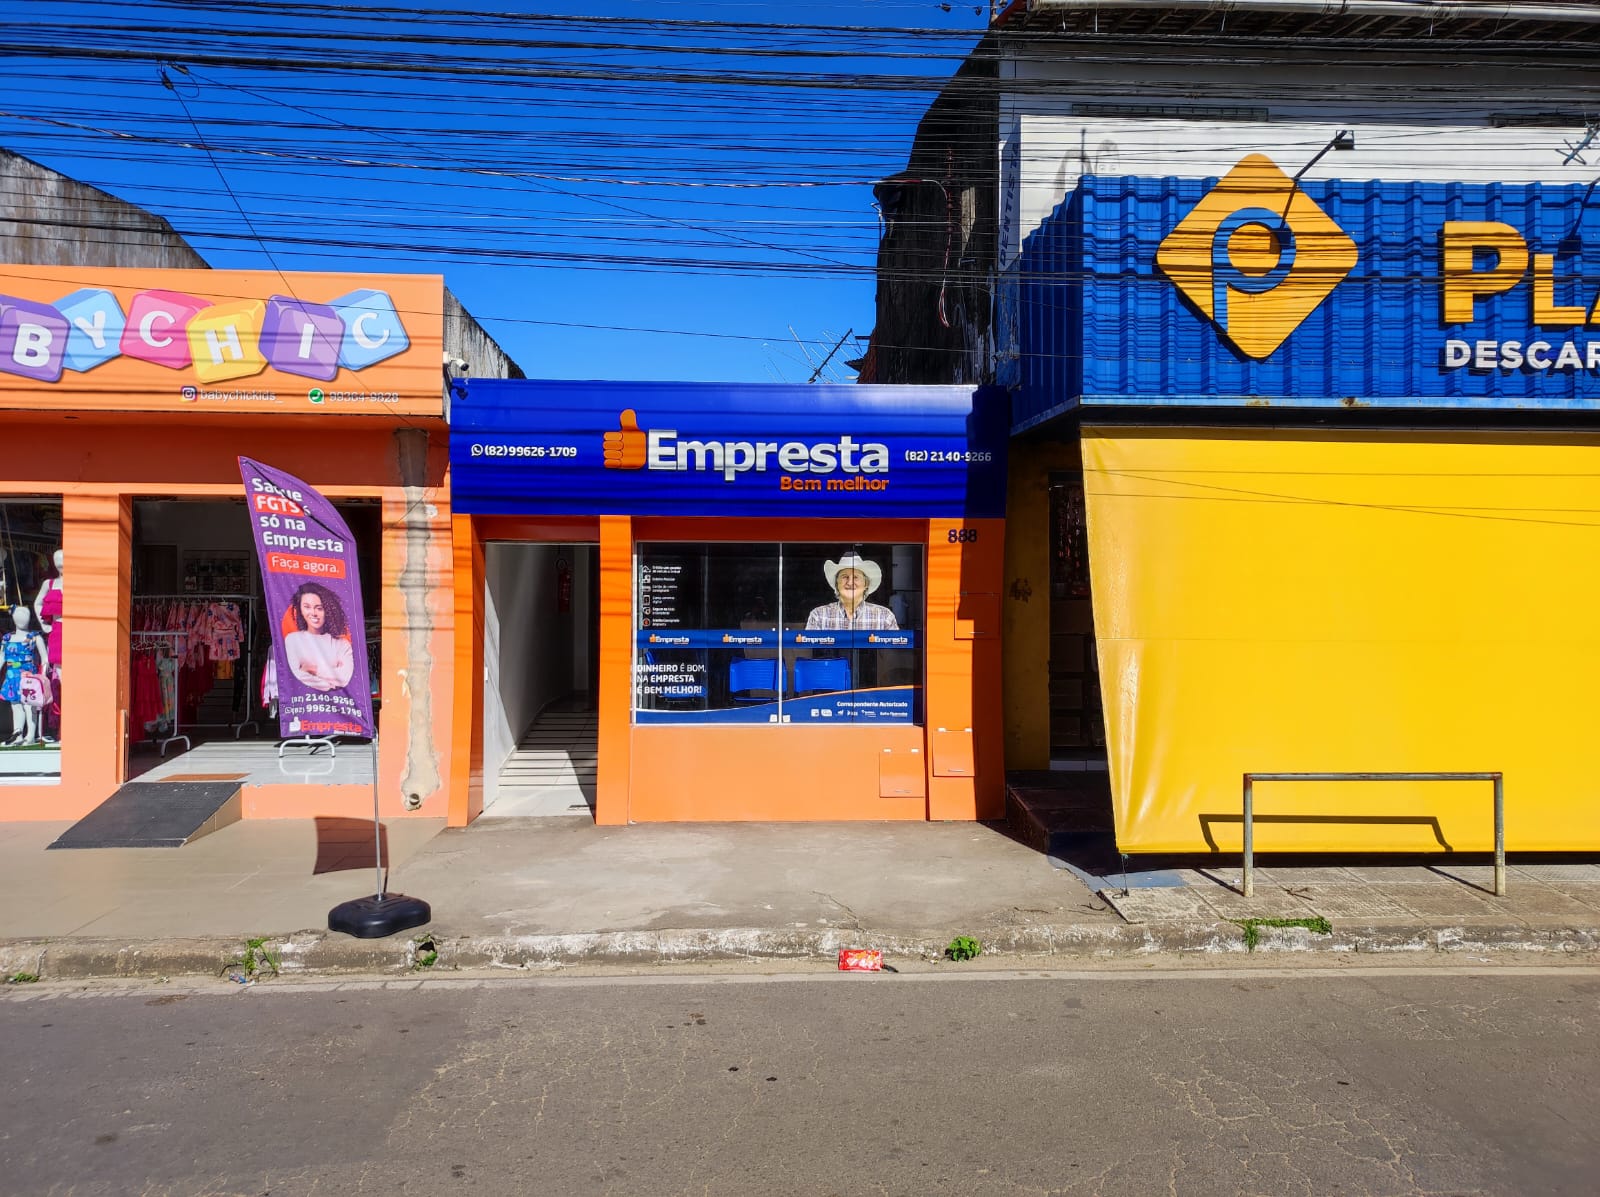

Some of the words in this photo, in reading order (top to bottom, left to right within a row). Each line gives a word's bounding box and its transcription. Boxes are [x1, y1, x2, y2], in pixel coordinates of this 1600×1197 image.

[1443, 220, 1600, 325] PL
[648, 428, 889, 481] Empresta
[905, 449, 928, 461] (82)
[930, 451, 991, 462] 2140-9266
[780, 476, 822, 491] Bem
[827, 476, 889, 491] melhor
[256, 495, 301, 513] FGTS
[260, 514, 280, 528] só
[285, 518, 306, 532] na
[263, 531, 344, 553] Empresta
[947, 529, 977, 543] 888
[272, 555, 300, 571] Faça
[303, 559, 340, 574] agora.
[655, 636, 689, 644] Empresta
[728, 636, 762, 644] Empresta
[801, 636, 835, 644] Empresta
[874, 636, 908, 644] Empresta
[637, 664, 678, 672] DINHEIRO
[650, 674, 695, 683] EMPRESTA
[644, 686, 662, 694] BEM
[664, 685, 702, 694] MELHOR!
[301, 719, 362, 732] Empresta
